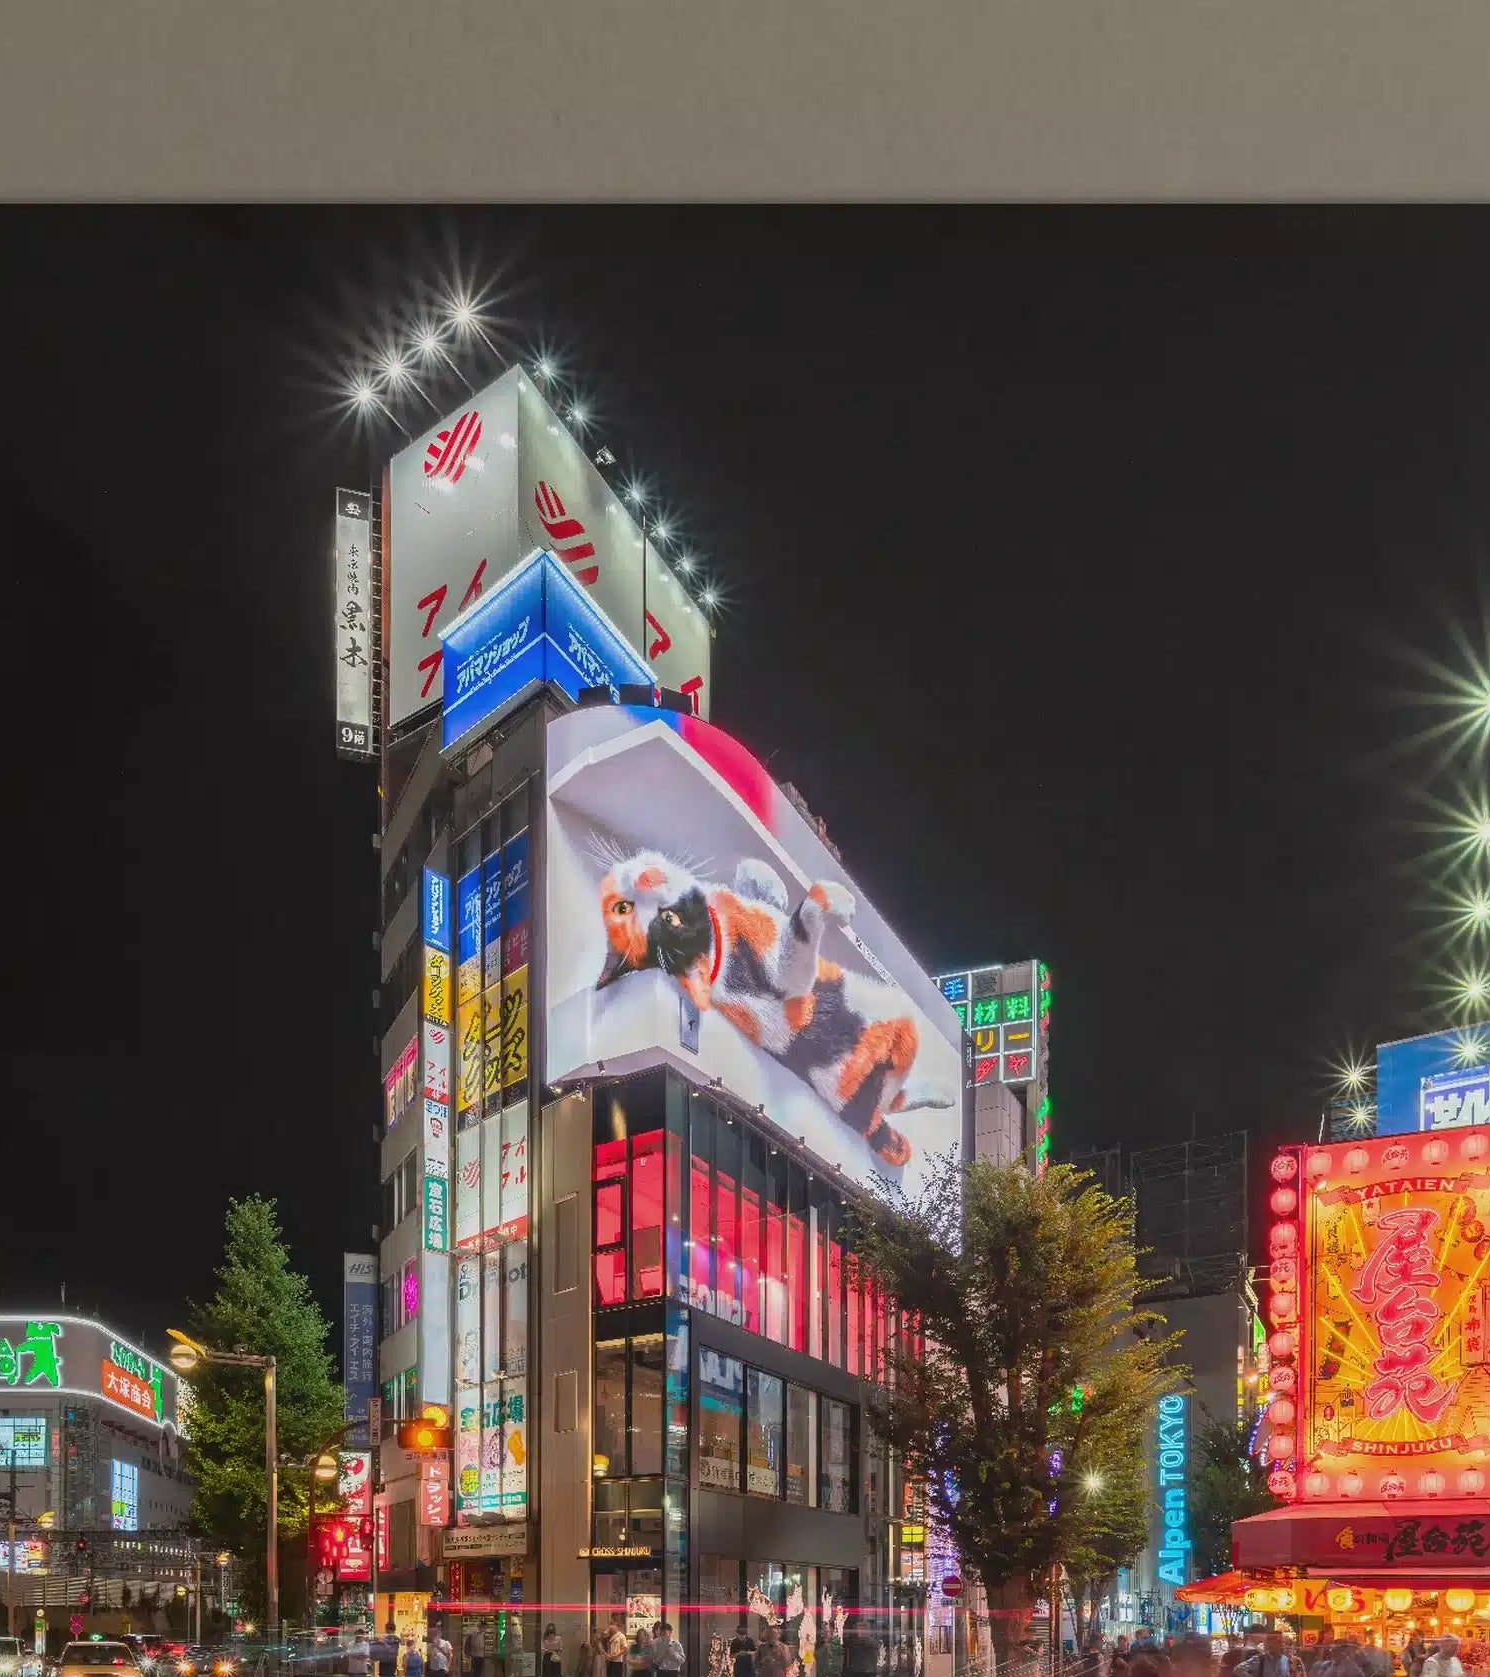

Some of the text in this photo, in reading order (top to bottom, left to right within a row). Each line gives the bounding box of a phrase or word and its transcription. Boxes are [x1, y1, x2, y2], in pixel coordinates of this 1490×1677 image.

[456, 616, 531, 693] アパマンショップ
[1359, 1178, 1455, 1200] YATAIEN
[348, 1262, 375, 1275] HIS
[106, 1371, 153, 1410] 大塚商会
[1161, 1394, 1185, 1487] TOKYO
[1351, 1438, 1453, 1455] SHINJUKU
[1158, 1488, 1193, 1586] Alpen
